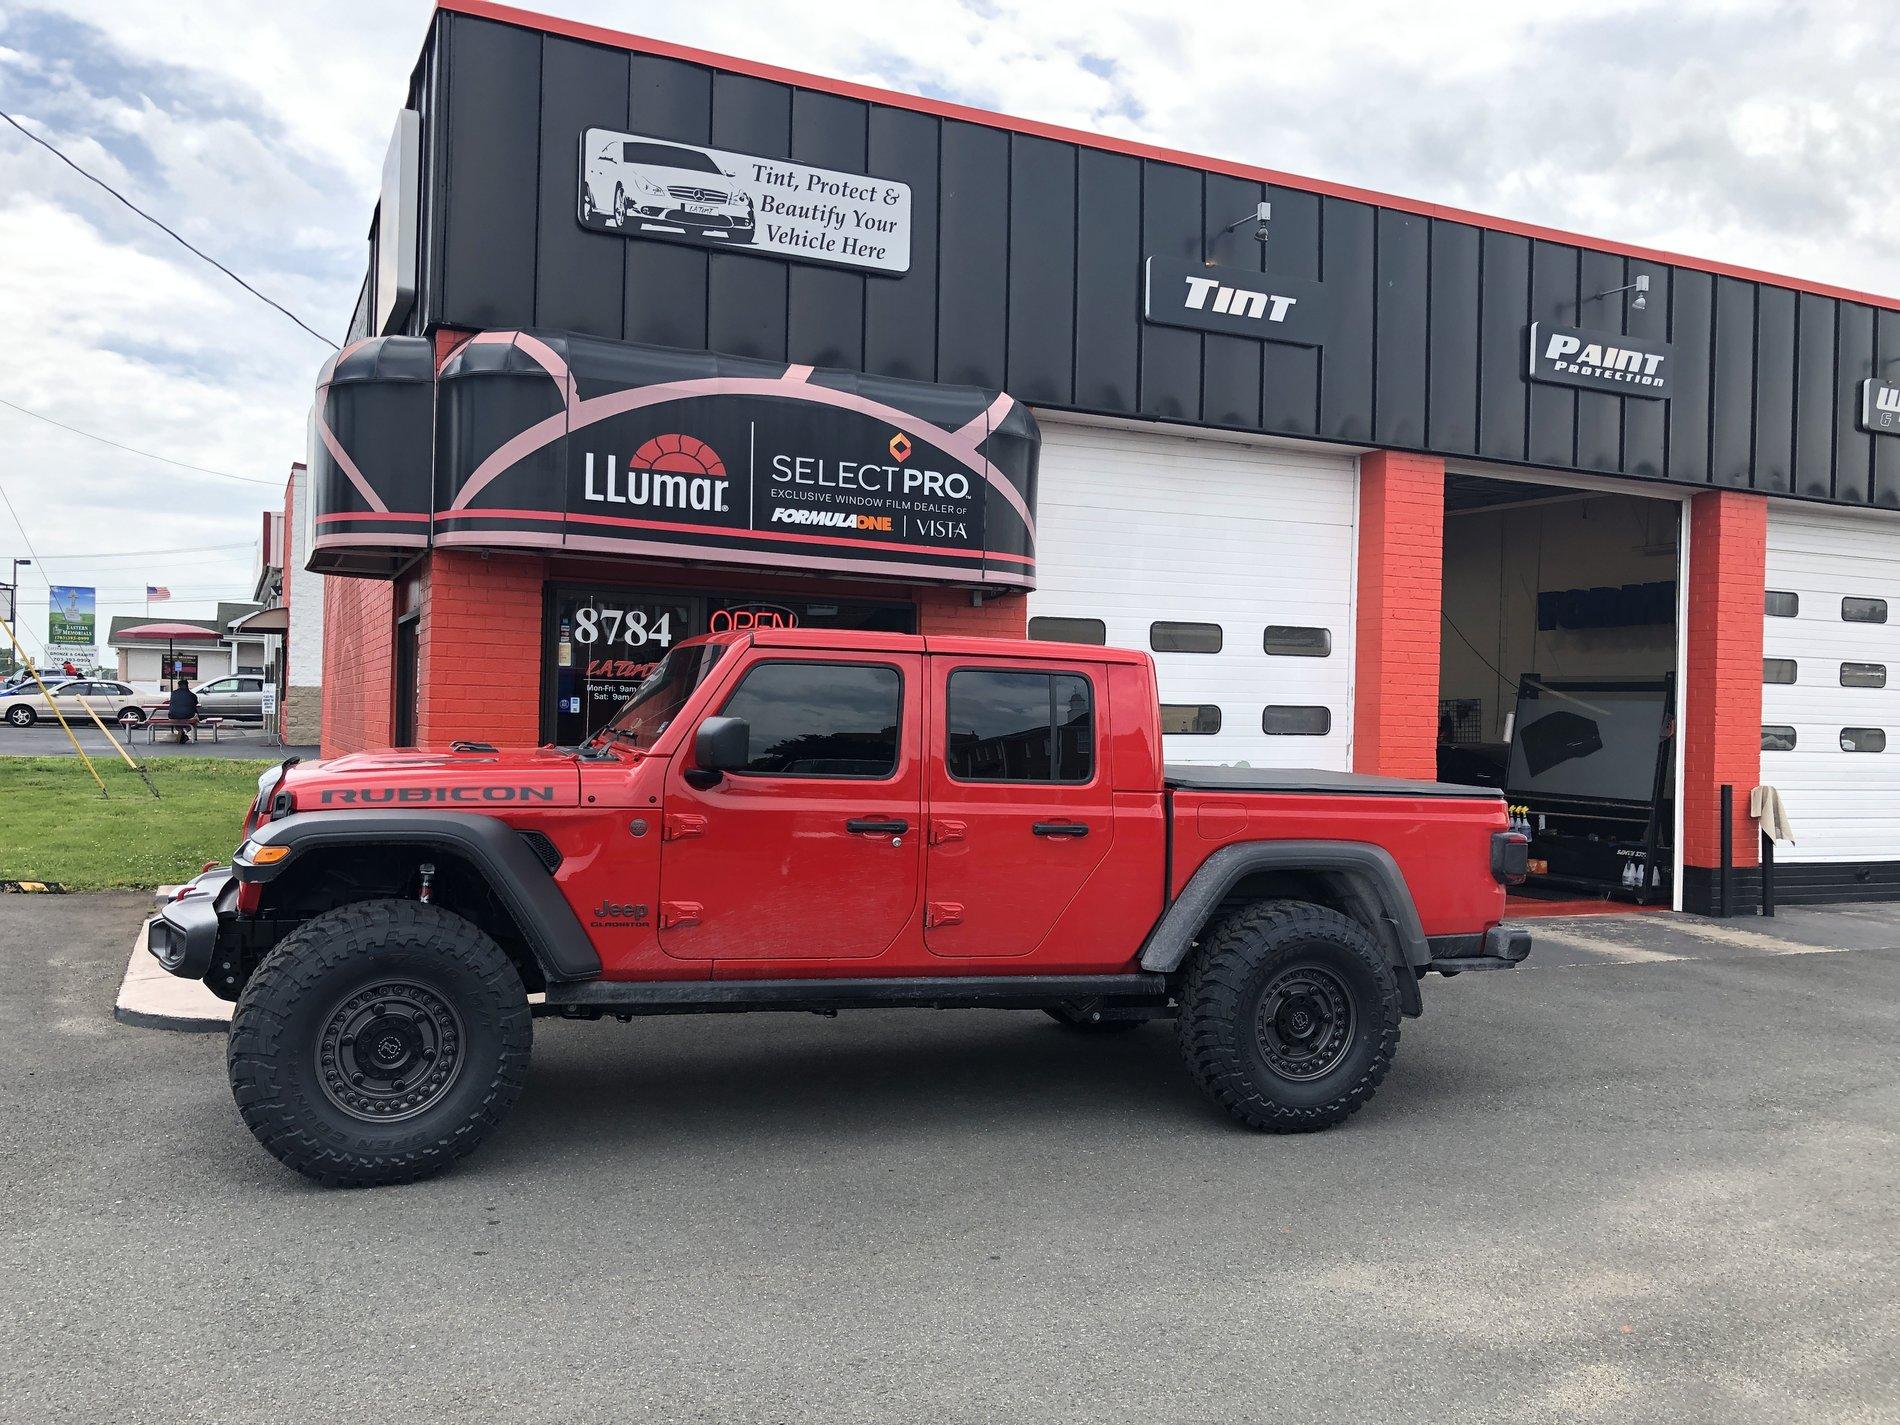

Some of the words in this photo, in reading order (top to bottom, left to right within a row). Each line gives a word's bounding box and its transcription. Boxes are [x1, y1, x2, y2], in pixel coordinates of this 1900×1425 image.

[752, 163, 800, 192] Tint,
[806, 173, 878, 203] Protect
[883, 188, 900, 206] &
[760, 194, 846, 231] Beautify
[852, 209, 898, 233] Your
[766, 223, 836, 252] Vehicle
[840, 235, 886, 260] Here
[1544, 333, 1665, 376] PAINT
[1554, 360, 1665, 387] PROTECTION
[584, 452, 729, 512] LLumar
[770, 488, 832, 503] EXCLUSIVE
[835, 494, 884, 508] WINDOW
[886, 499, 911, 511] FILM
[914, 502, 954, 514] DEALER
[956, 507, 968, 515] OF
[916, 518, 968, 540] VISTA
[574, 607, 672, 648] 8784
[710, 610, 793, 633] OPEN
[586, 684, 616, 692] Mon-Fri:
[619, 685, 637, 693] 9am
[612, 693, 630, 701] 9am
[321, 786, 553, 804] RUBICON
[594, 899, 649, 920] Jeep
